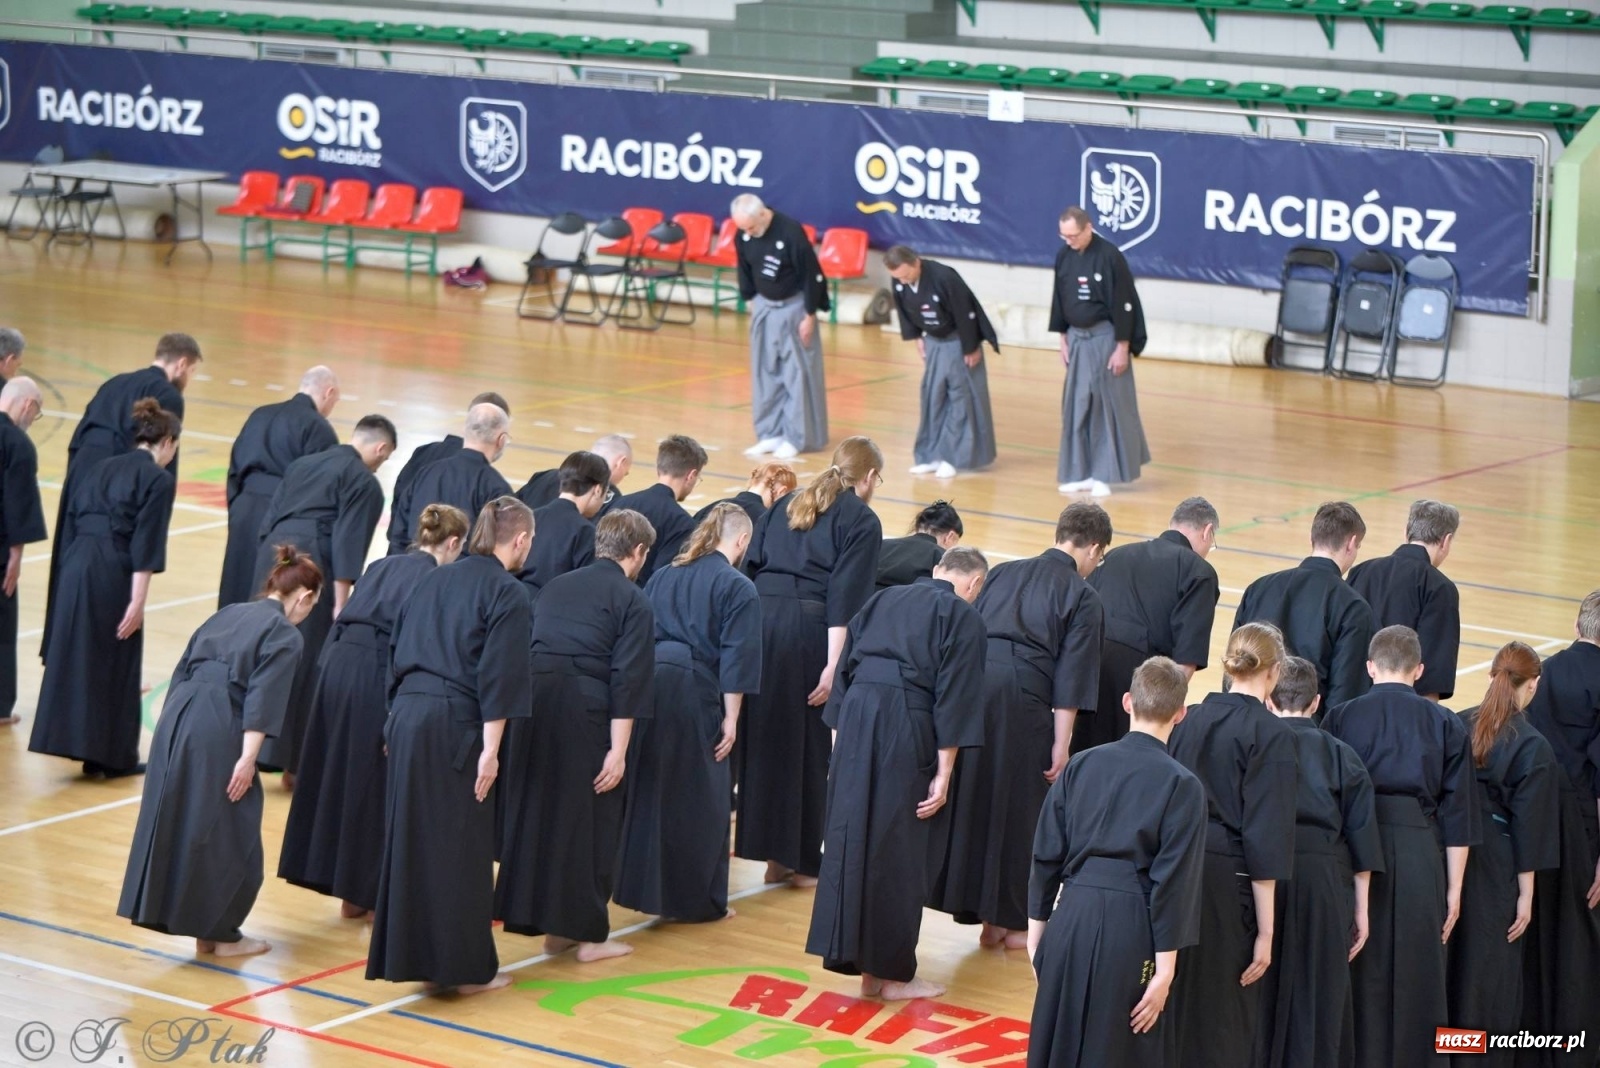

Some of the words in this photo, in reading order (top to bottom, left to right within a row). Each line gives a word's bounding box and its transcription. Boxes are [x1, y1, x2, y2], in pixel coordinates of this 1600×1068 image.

[37, 84, 204, 136] RACIBÓRZ
[318, 147, 382, 168] RACIBÓRZ
[560, 131, 764, 188] RACIBÓRZ
[902, 201, 982, 225] RACIBÓRZ
[1203, 188, 1457, 253] RACIBÓRZ
